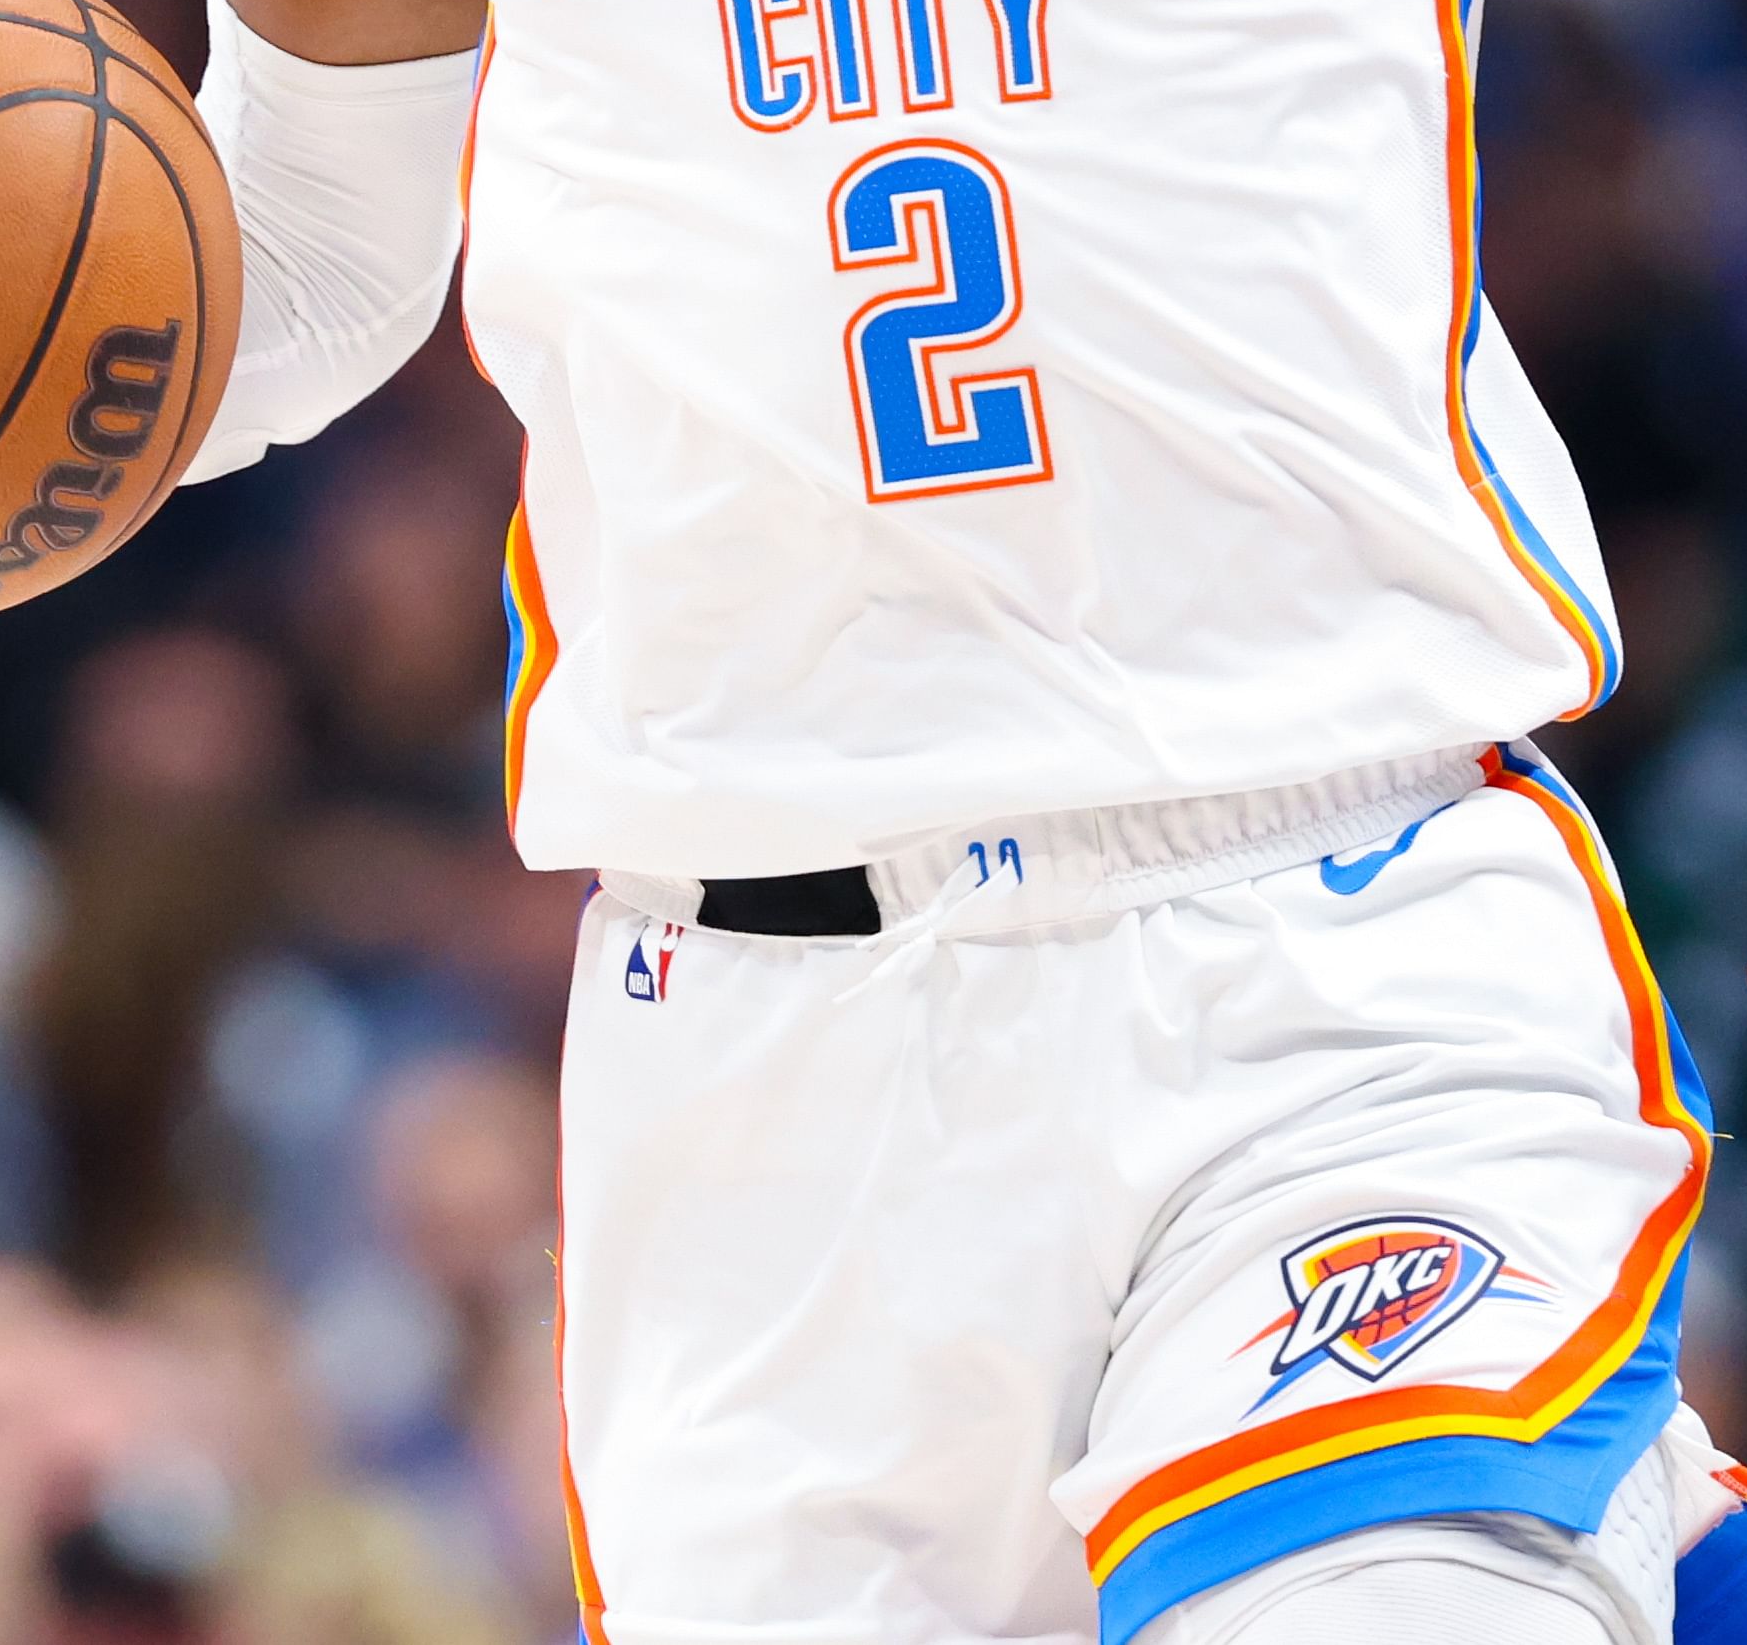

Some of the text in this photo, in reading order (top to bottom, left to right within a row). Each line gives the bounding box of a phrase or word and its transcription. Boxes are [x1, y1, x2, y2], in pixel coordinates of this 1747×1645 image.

[827, 137, 1055, 504] 2
[628, 971, 652, 996] NBA
[1273, 1244, 1455, 1369] OKC
